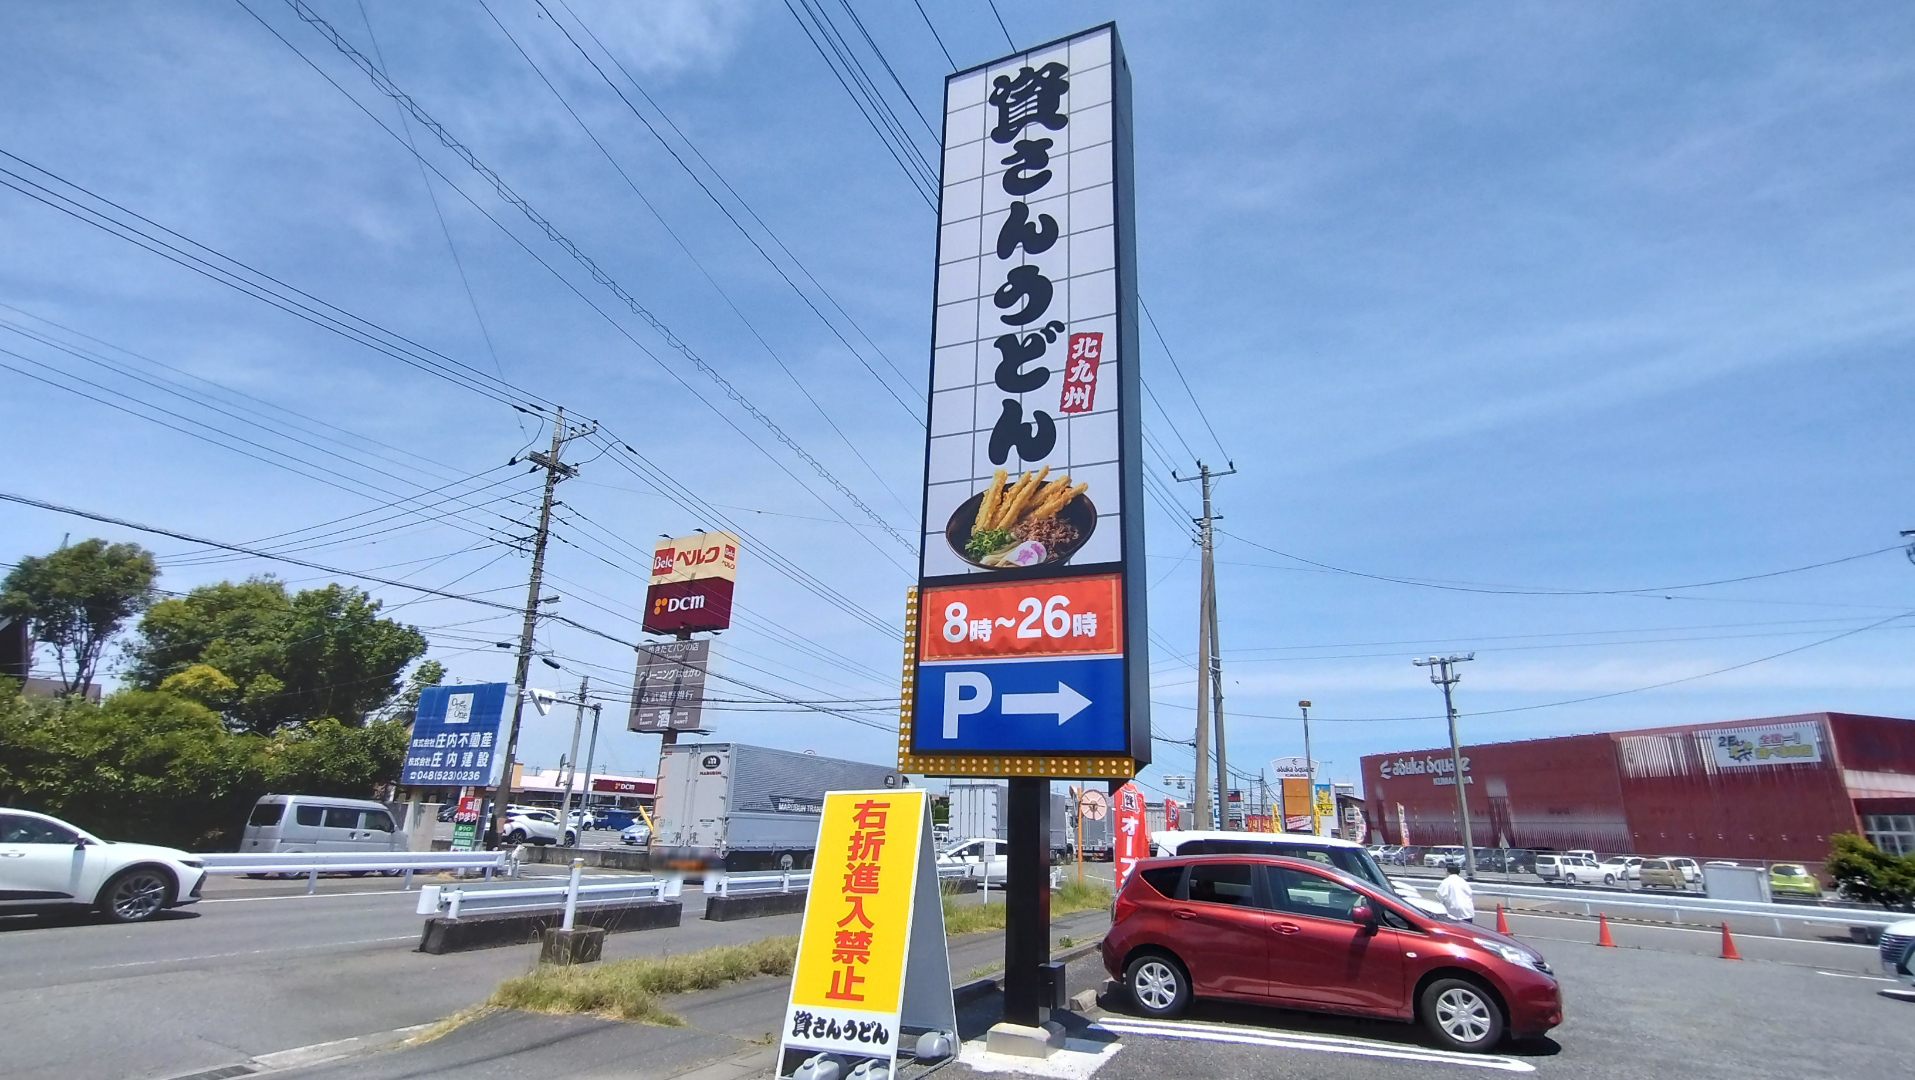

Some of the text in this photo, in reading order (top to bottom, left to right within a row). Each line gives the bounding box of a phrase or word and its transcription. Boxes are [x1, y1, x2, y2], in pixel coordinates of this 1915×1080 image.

[988, 62, 1070, 465] 資さんうどん
[1064, 336, 1099, 411] 北九州
[654, 555, 673, 569] Belc
[676, 546, 720, 566] ベルク
[657, 710, 671, 727] 酒
[943, 671, 993, 739] P
[417, 771, 480, 780] 048(523)0236
[825, 800, 890, 1001] 右折進入禁止
[792, 1010, 889, 1045] 資さんうどん
